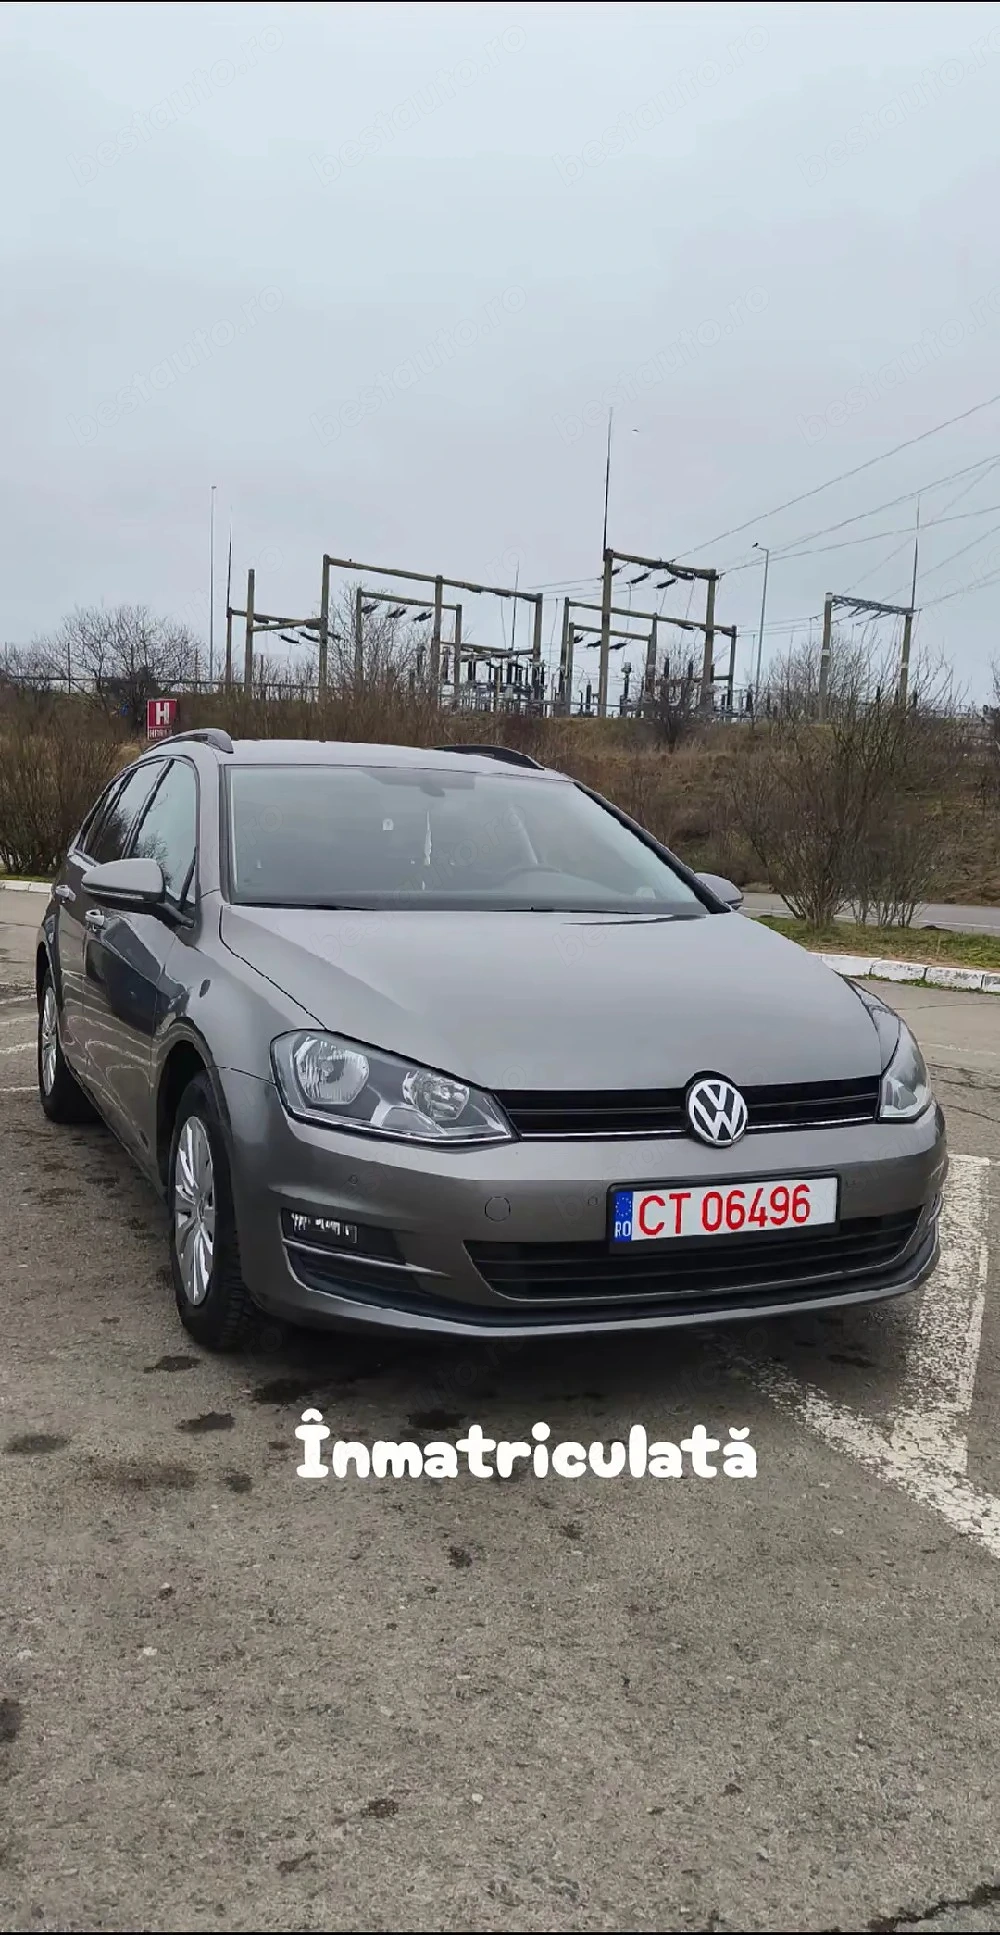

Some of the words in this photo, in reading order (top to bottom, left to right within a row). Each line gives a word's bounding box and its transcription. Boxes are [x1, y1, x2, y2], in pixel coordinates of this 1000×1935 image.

[155, 702, 170, 725] H
[638, 1192, 692, 1236] CT
[701, 1183, 811, 1232] 06496
[614, 1220, 632, 1239] RO
